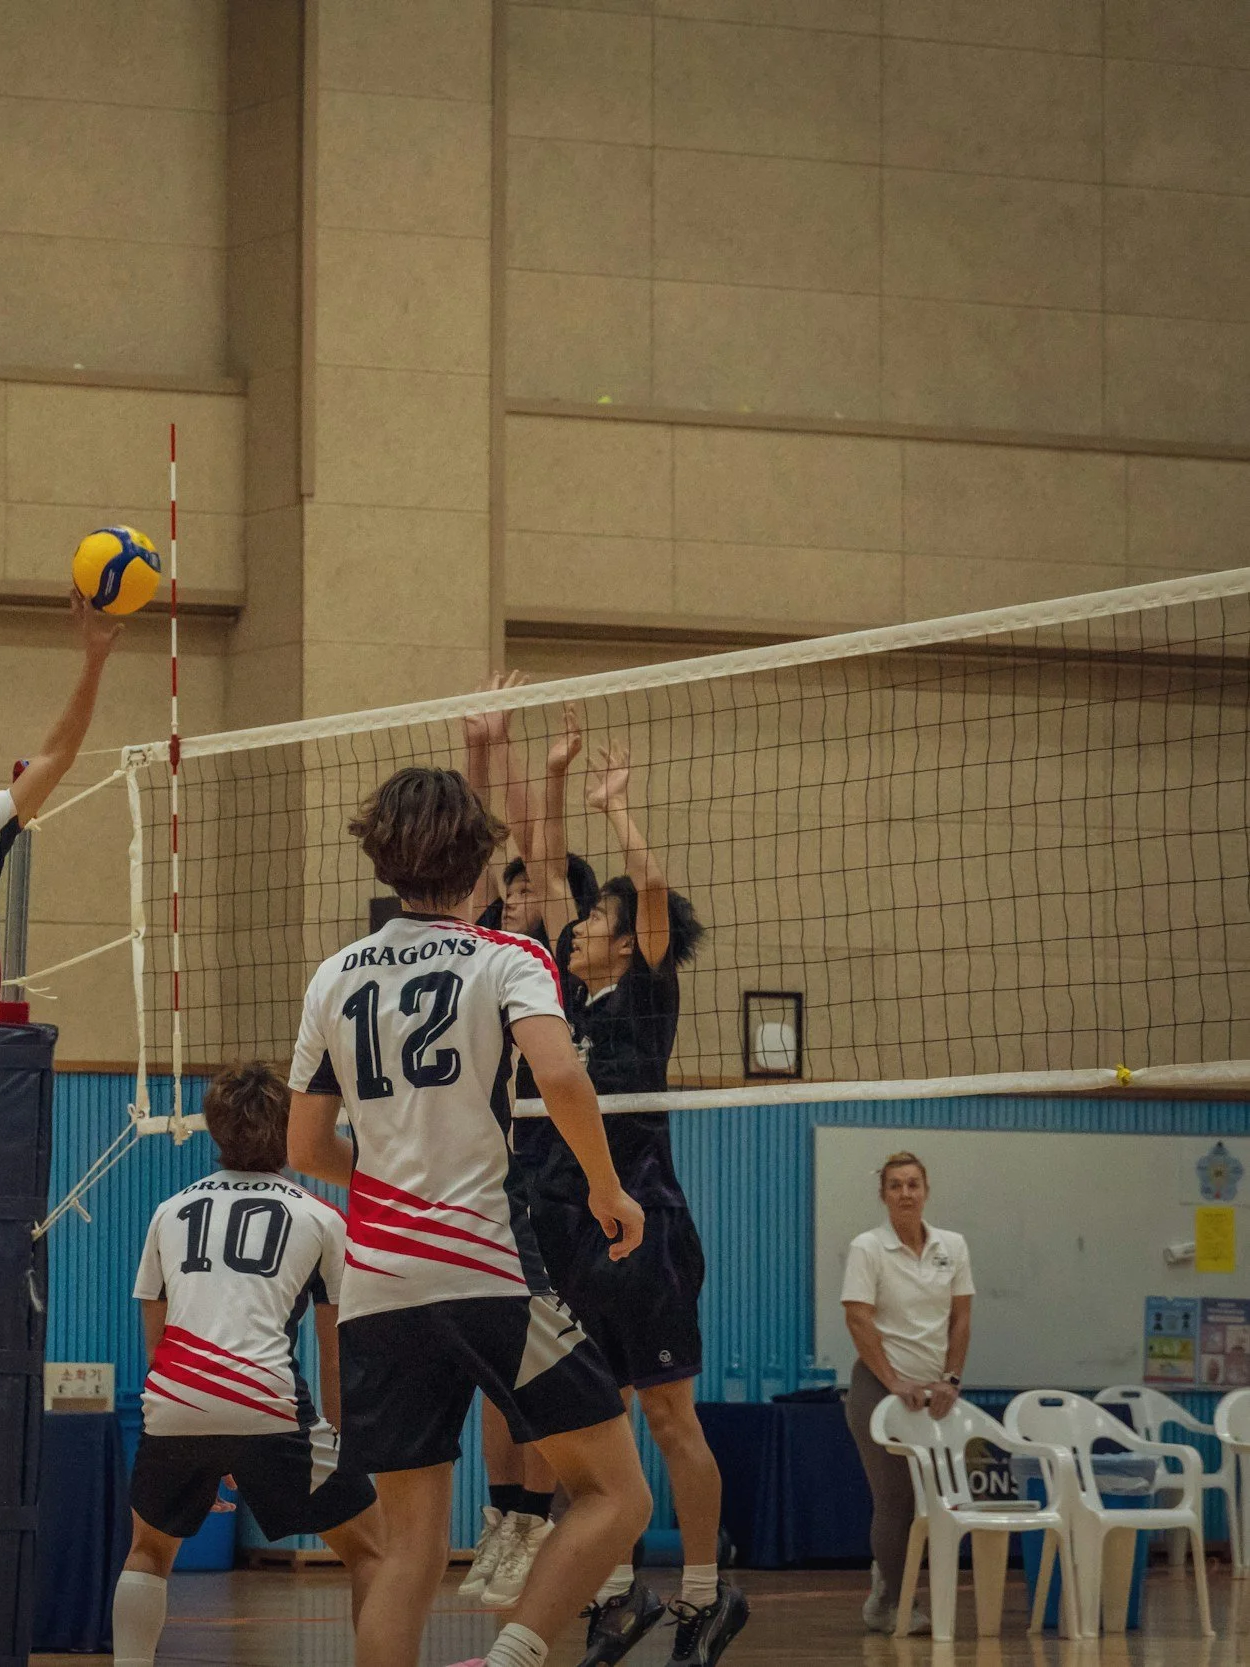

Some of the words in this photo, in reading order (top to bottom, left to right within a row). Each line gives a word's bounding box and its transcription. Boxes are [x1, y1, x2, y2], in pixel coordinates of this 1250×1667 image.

[341, 938, 477, 973] DRAGONS
[342, 969, 464, 1100] 12
[182, 1181, 303, 1199] DRAGONS
[177, 1197, 293, 1278] 10
